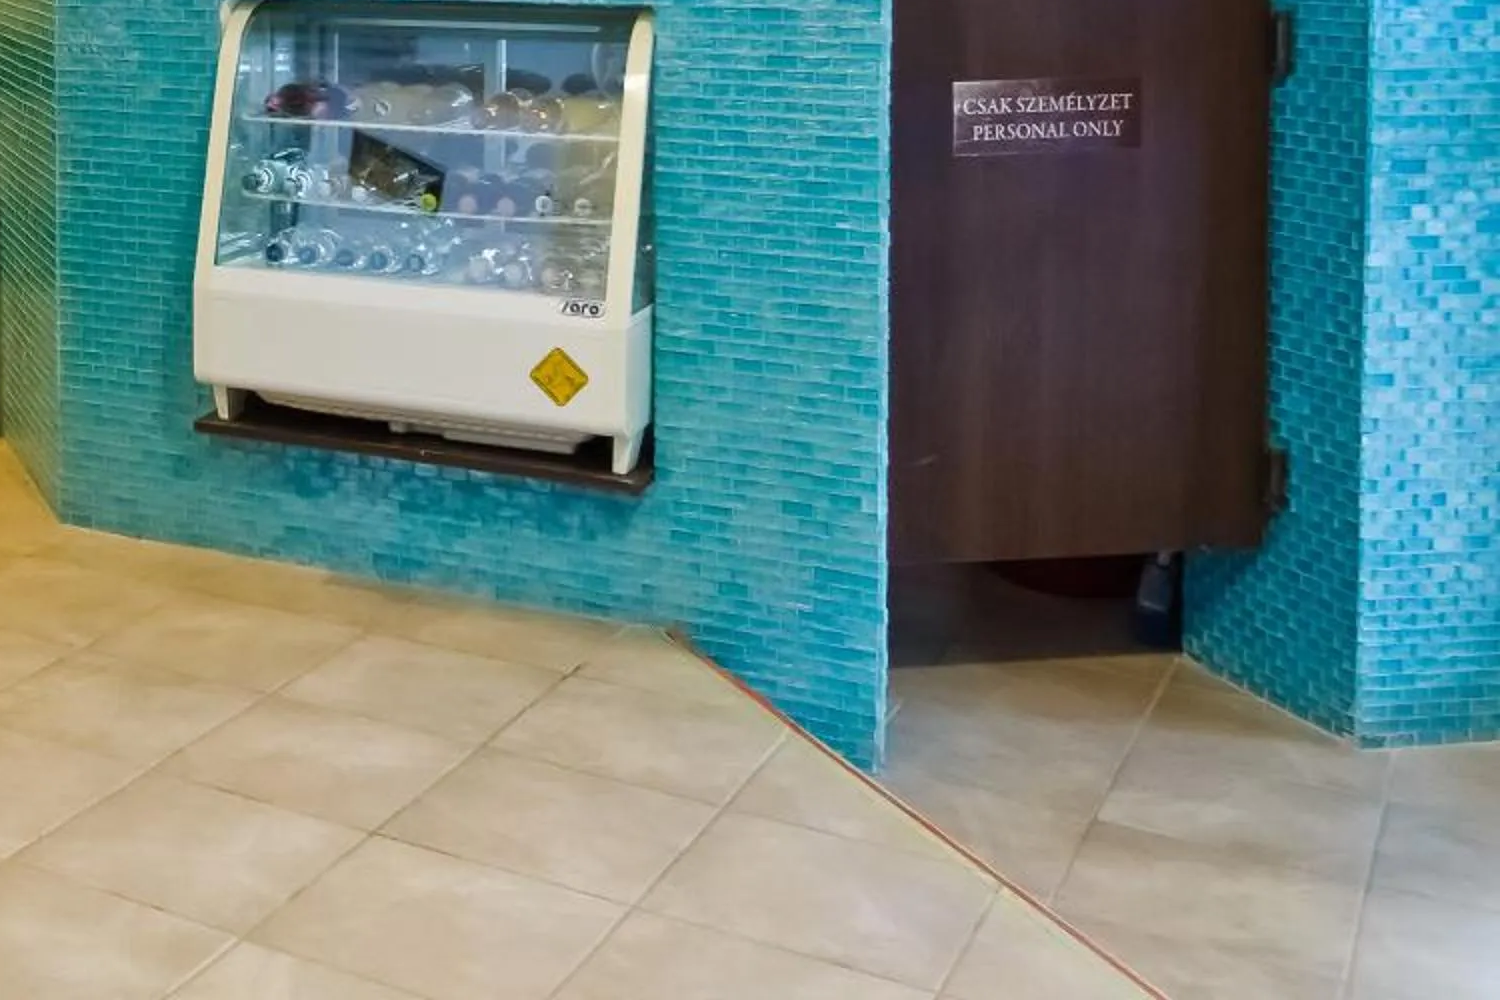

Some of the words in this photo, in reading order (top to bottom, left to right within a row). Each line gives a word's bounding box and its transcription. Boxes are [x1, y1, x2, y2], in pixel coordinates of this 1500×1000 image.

[963, 96, 1013, 115] CSAK
[1016, 92, 1133, 113] SZEMÉLYZET
[973, 121, 1071, 141] PERSONAL
[1073, 119, 1124, 138] ONLY
